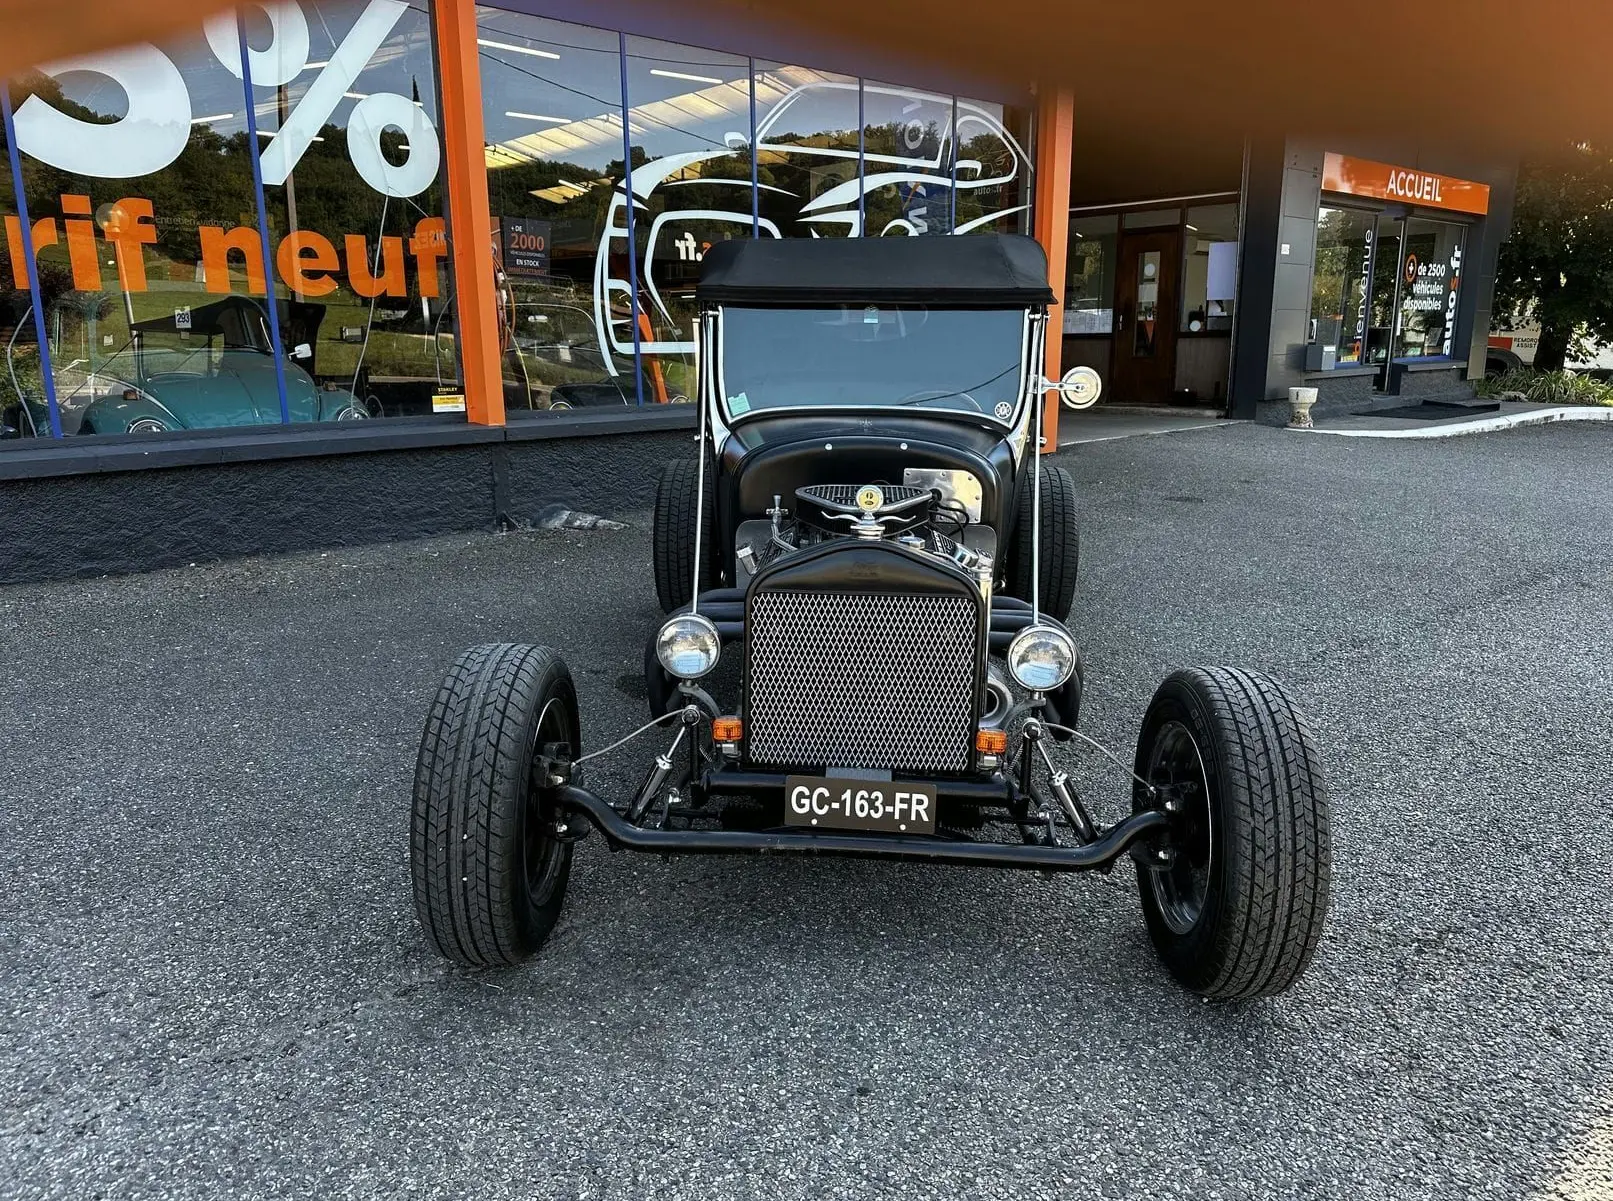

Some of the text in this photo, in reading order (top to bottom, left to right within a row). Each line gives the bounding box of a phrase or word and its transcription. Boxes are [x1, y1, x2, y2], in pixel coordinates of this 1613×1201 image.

[1386, 169, 1442, 202] ACCUEIL
[199, 216, 448, 296] neuf
[510, 232, 545, 251] 2000
[1417, 262, 1427, 275] de
[1427, 263, 1446, 277] 2500
[1352, 230, 1373, 356] bienvenue
[1403, 296, 1442, 311] disponibles
[1412, 281, 1444, 295] véhicules
[1443, 245, 1461, 355] autos.fr
[791, 785, 930, 822] GC-163-FR
